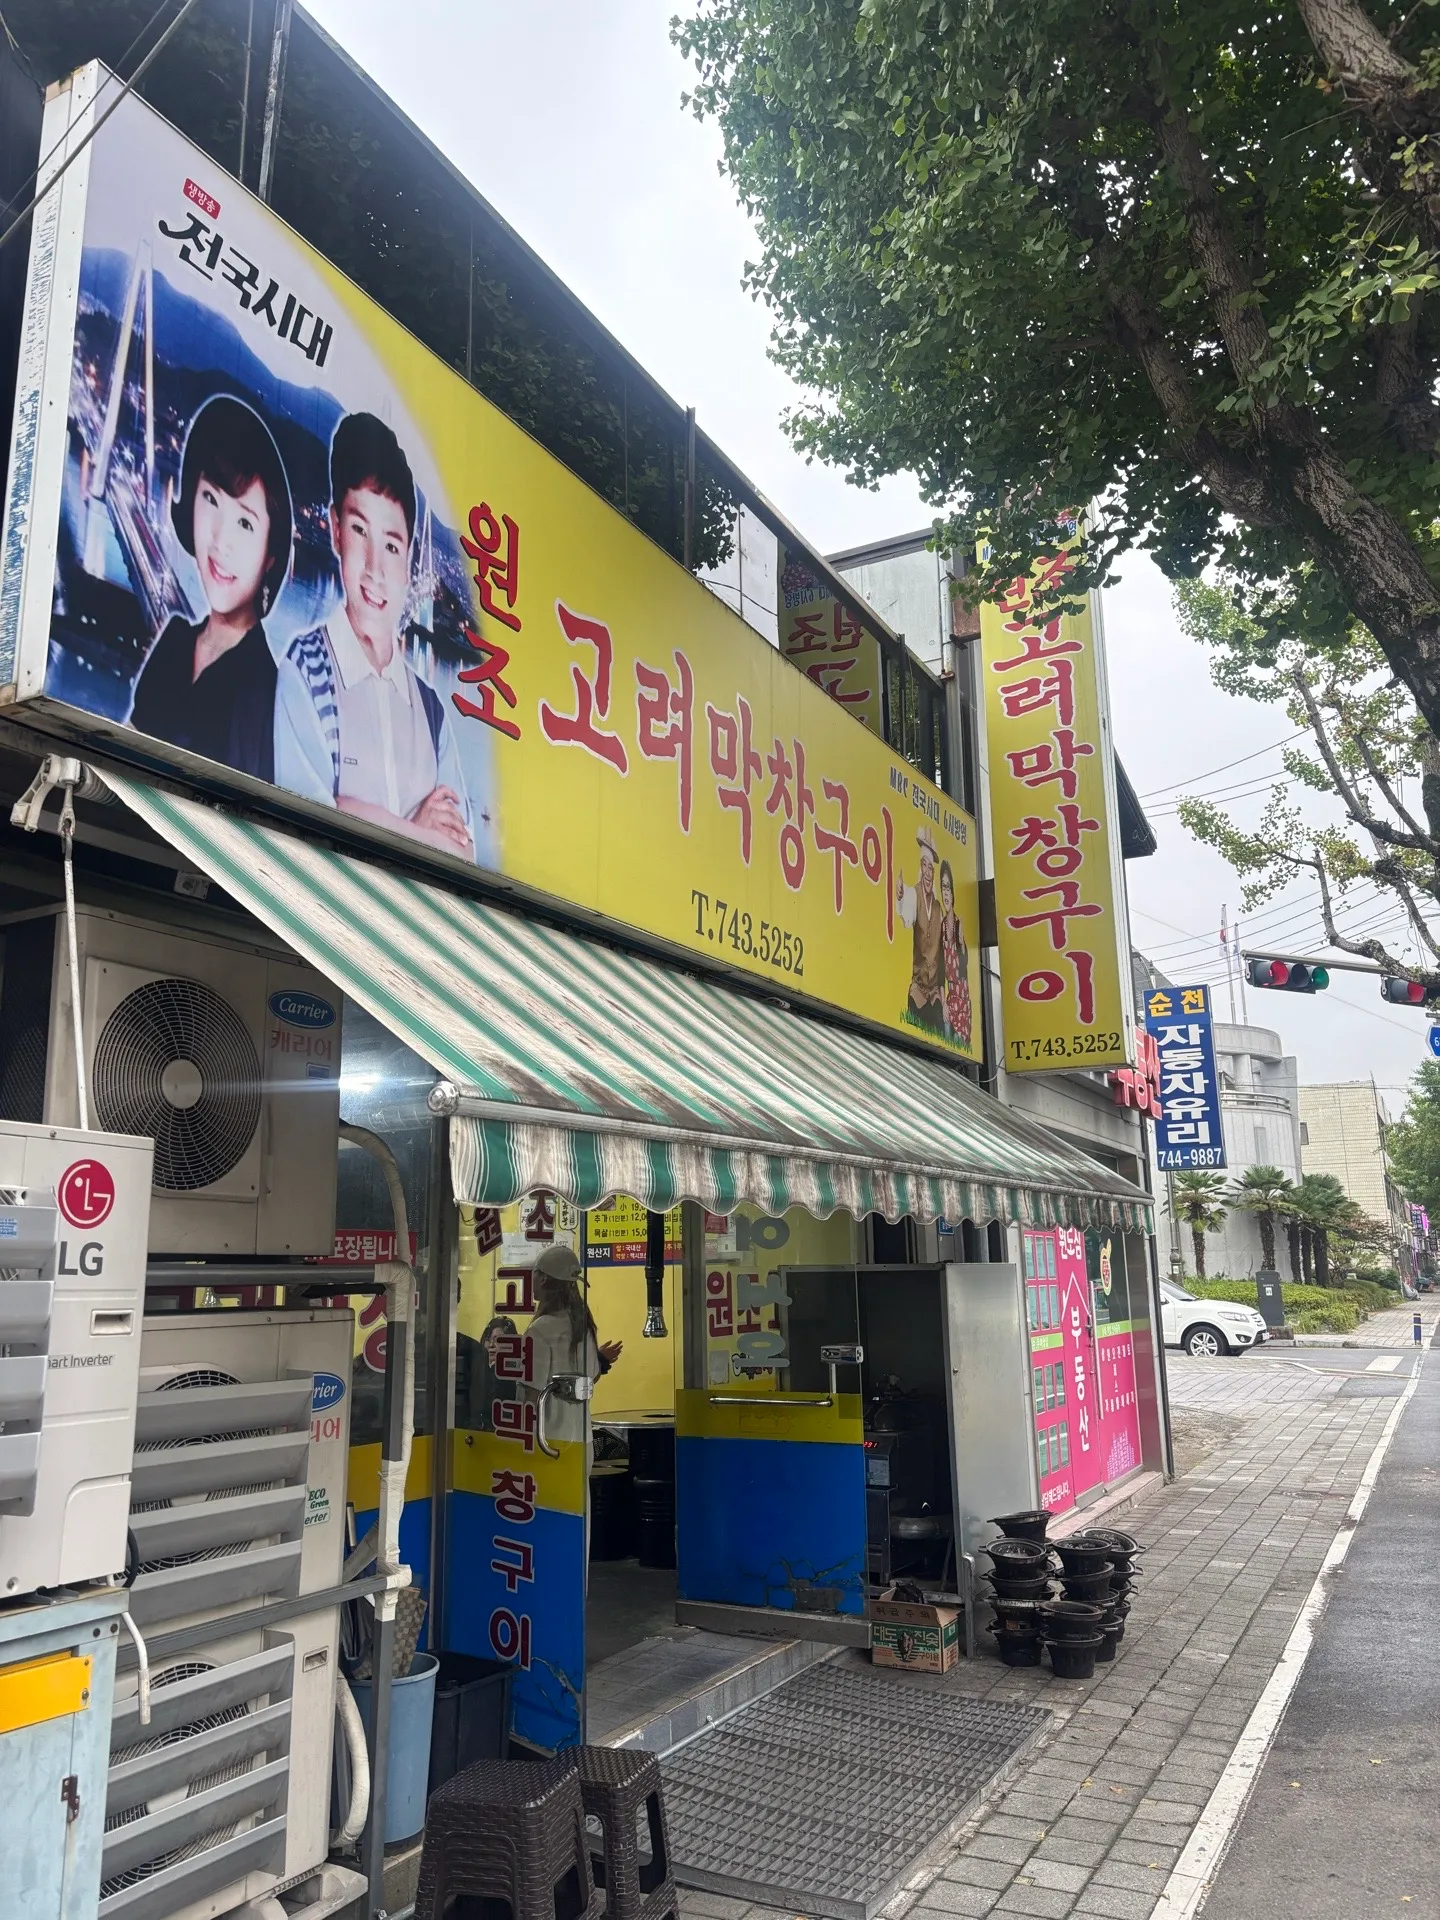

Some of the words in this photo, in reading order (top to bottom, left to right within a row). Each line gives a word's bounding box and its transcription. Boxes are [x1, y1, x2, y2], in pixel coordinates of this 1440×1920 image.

[188, 183, 216, 213] 생방송
[158, 212, 334, 368] 전국시대
[453, 501, 522, 742] 원조
[538, 596, 897, 944] 고려막창구이
[890, 767, 908, 798] MBC
[912, 783, 940, 826] 전국시대
[943, 810, 967, 846] 6시방영
[991, 611, 1103, 1026] 고려막창구이
[691, 889, 806, 978] T.743.5252
[279, 997, 328, 1020] Carrier
[1148, 988, 1206, 1017] 순천
[270, 1029, 332, 1061] 캐리어
[1010, 1033, 1122, 1063] T.743.5252
[1157, 1023, 1211, 1145] 자동차유리
[1158, 1147, 1222, 1169] 744-9887
[57, 1241, 104, 1277] LG
[328, 1235, 401, 1262] 포장됩니
[587, 1247, 611, 1259] 원산지
[48, 1356, 68, 1369] art
[70, 1354, 113, 1368] Inverter
[313, 1382, 338, 1399] rier
[1070, 1306, 1090, 1452] 부동산
[488, 1266, 538, 1672] 고려막창구이
[308, 1487, 326, 1501] ECO
[310, 1499, 330, 1509] Green
[304, 1511, 328, 1525] erter
[873, 1625, 898, 1642] 대도
